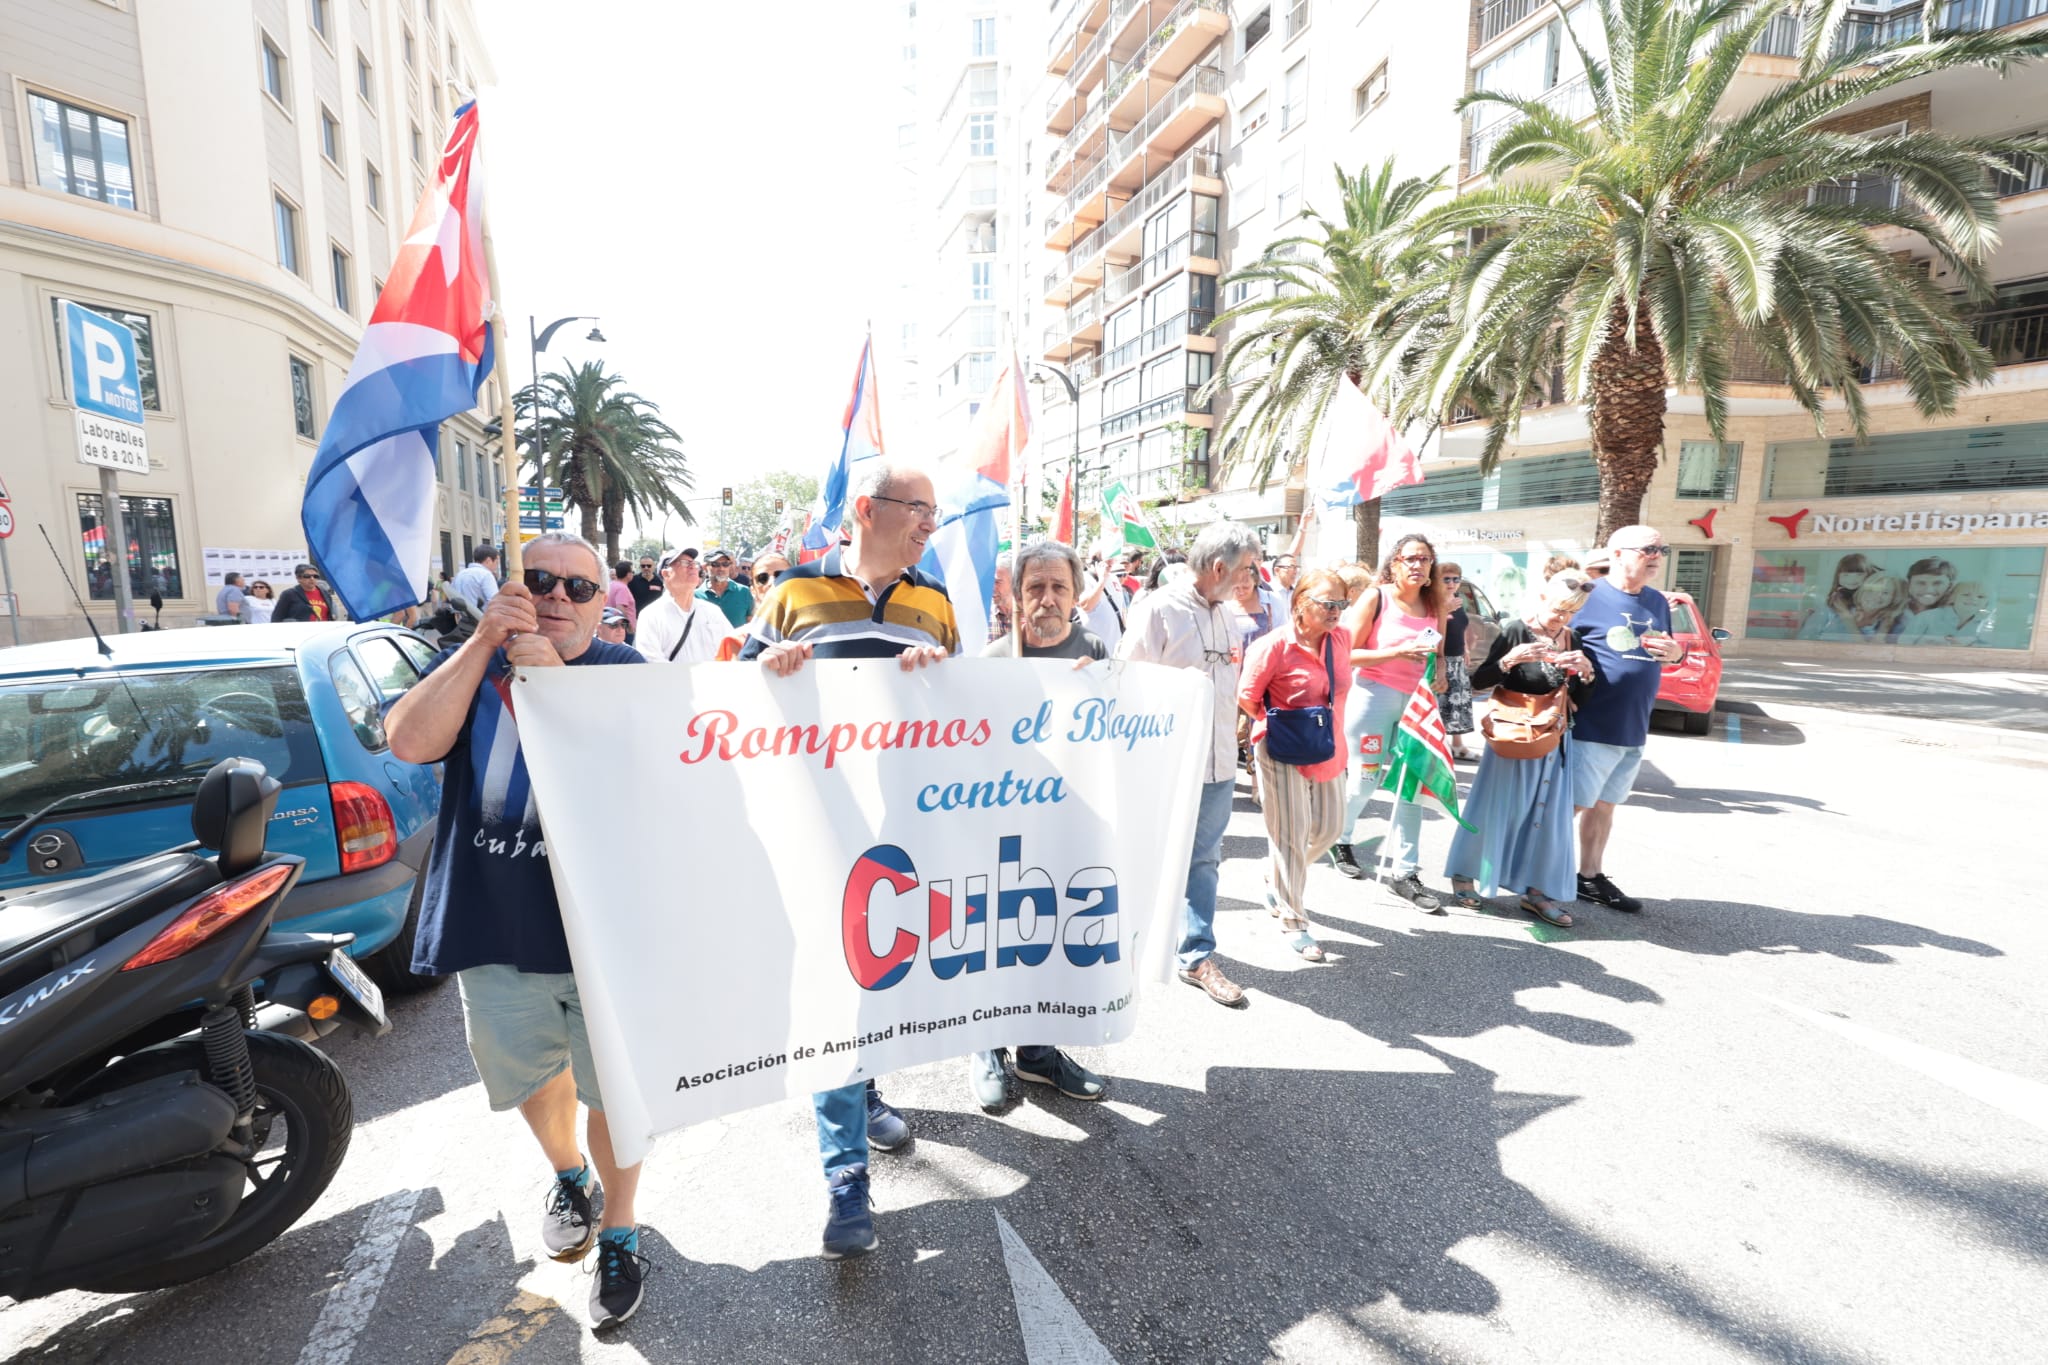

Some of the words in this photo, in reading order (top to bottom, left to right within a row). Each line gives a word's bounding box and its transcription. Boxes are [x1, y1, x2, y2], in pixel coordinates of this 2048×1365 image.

[82, 320, 126, 402] P
[104, 391, 139, 413] MOTOS
[81, 419, 145, 448] Laborables
[85, 443, 98, 457] de
[102, 446, 109, 459] 8
[112, 450, 119, 462] a
[122, 450, 134, 465] 20
[137, 451, 148, 468] h.
[1480, 527, 1523, 541] seguros
[1812, 510, 2048, 535] NorteHispana
[680, 709, 991, 769] Rompamos
[1011, 700, 1053, 744] el
[1066, 697, 1175, 752] Bloqueo
[916, 769, 1067, 813] contra
[473, 828, 548, 858] Cuba
[842, 835, 1121, 991] Cuba
[675, 1053, 787, 1092] Asociación
[793, 1046, 816, 1061] de
[822, 1026, 894, 1055] Amistad
[899, 1014, 967, 1035] Hispana
[972, 1004, 1032, 1022] Cubana
[1037, 1001, 1097, 1018] Málaga
